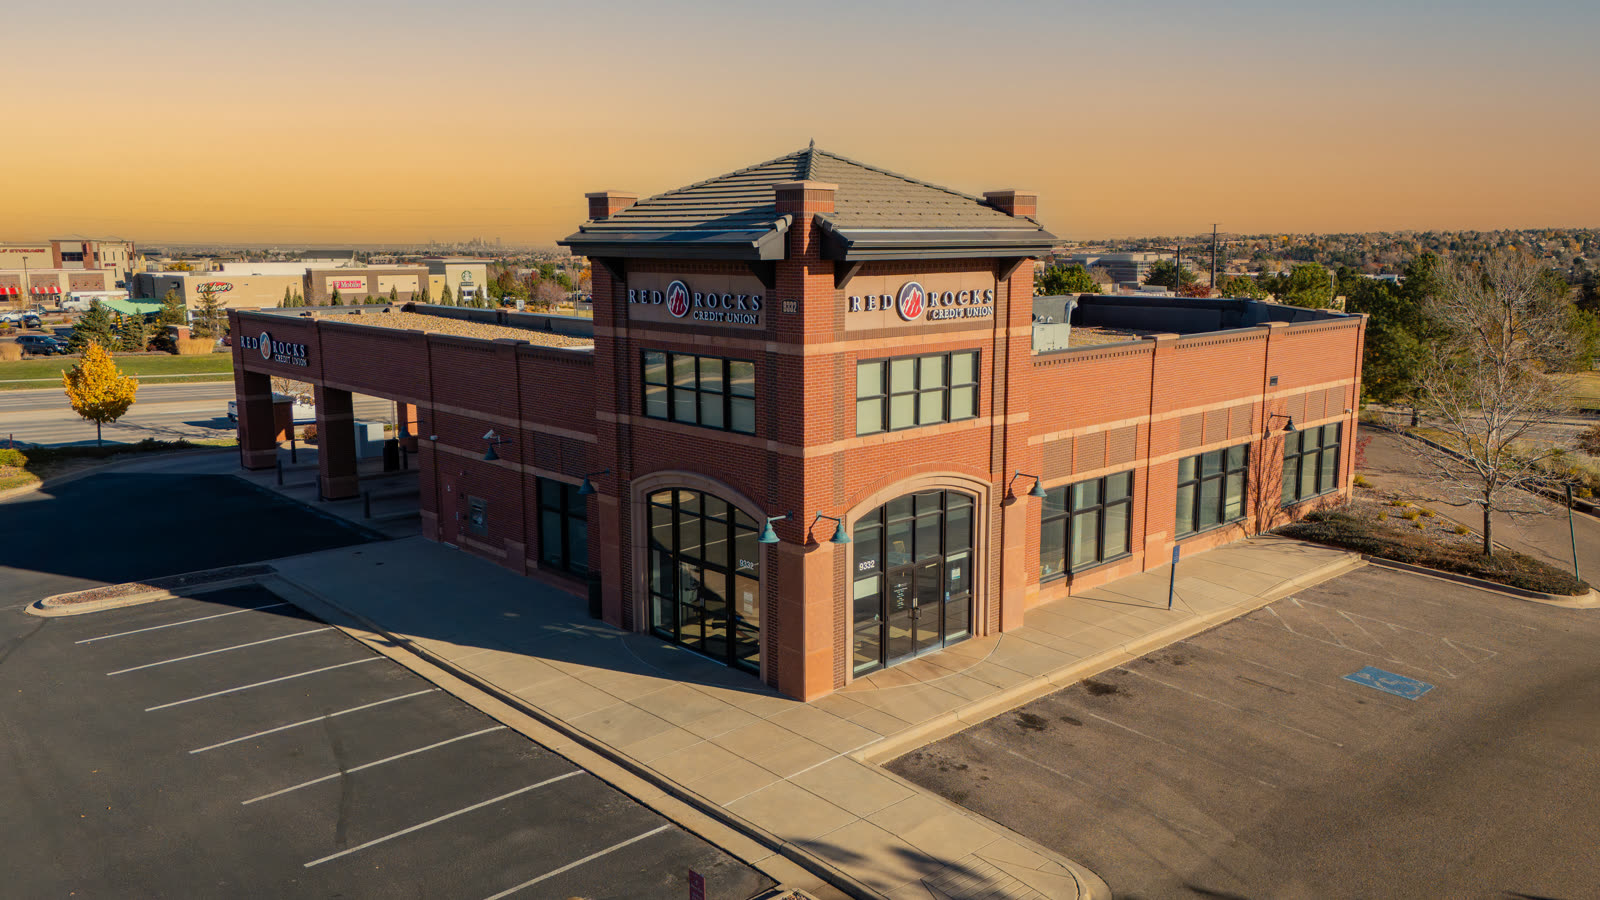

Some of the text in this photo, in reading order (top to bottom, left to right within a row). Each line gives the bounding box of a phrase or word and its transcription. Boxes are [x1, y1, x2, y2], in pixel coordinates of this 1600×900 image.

[629, 289, 762, 311] RED ROCKS
[851, 289, 993, 312] RED ROCKS
[693, 311, 757, 325] CREDIT UNION
[932, 306, 993, 320] CREDIT UNION
[240, 335, 305, 357] RED ROCKS
[275, 354, 307, 367] CREDIT UNION
[739, 559, 754, 570] 9332
[859, 560, 875, 571] 9332
